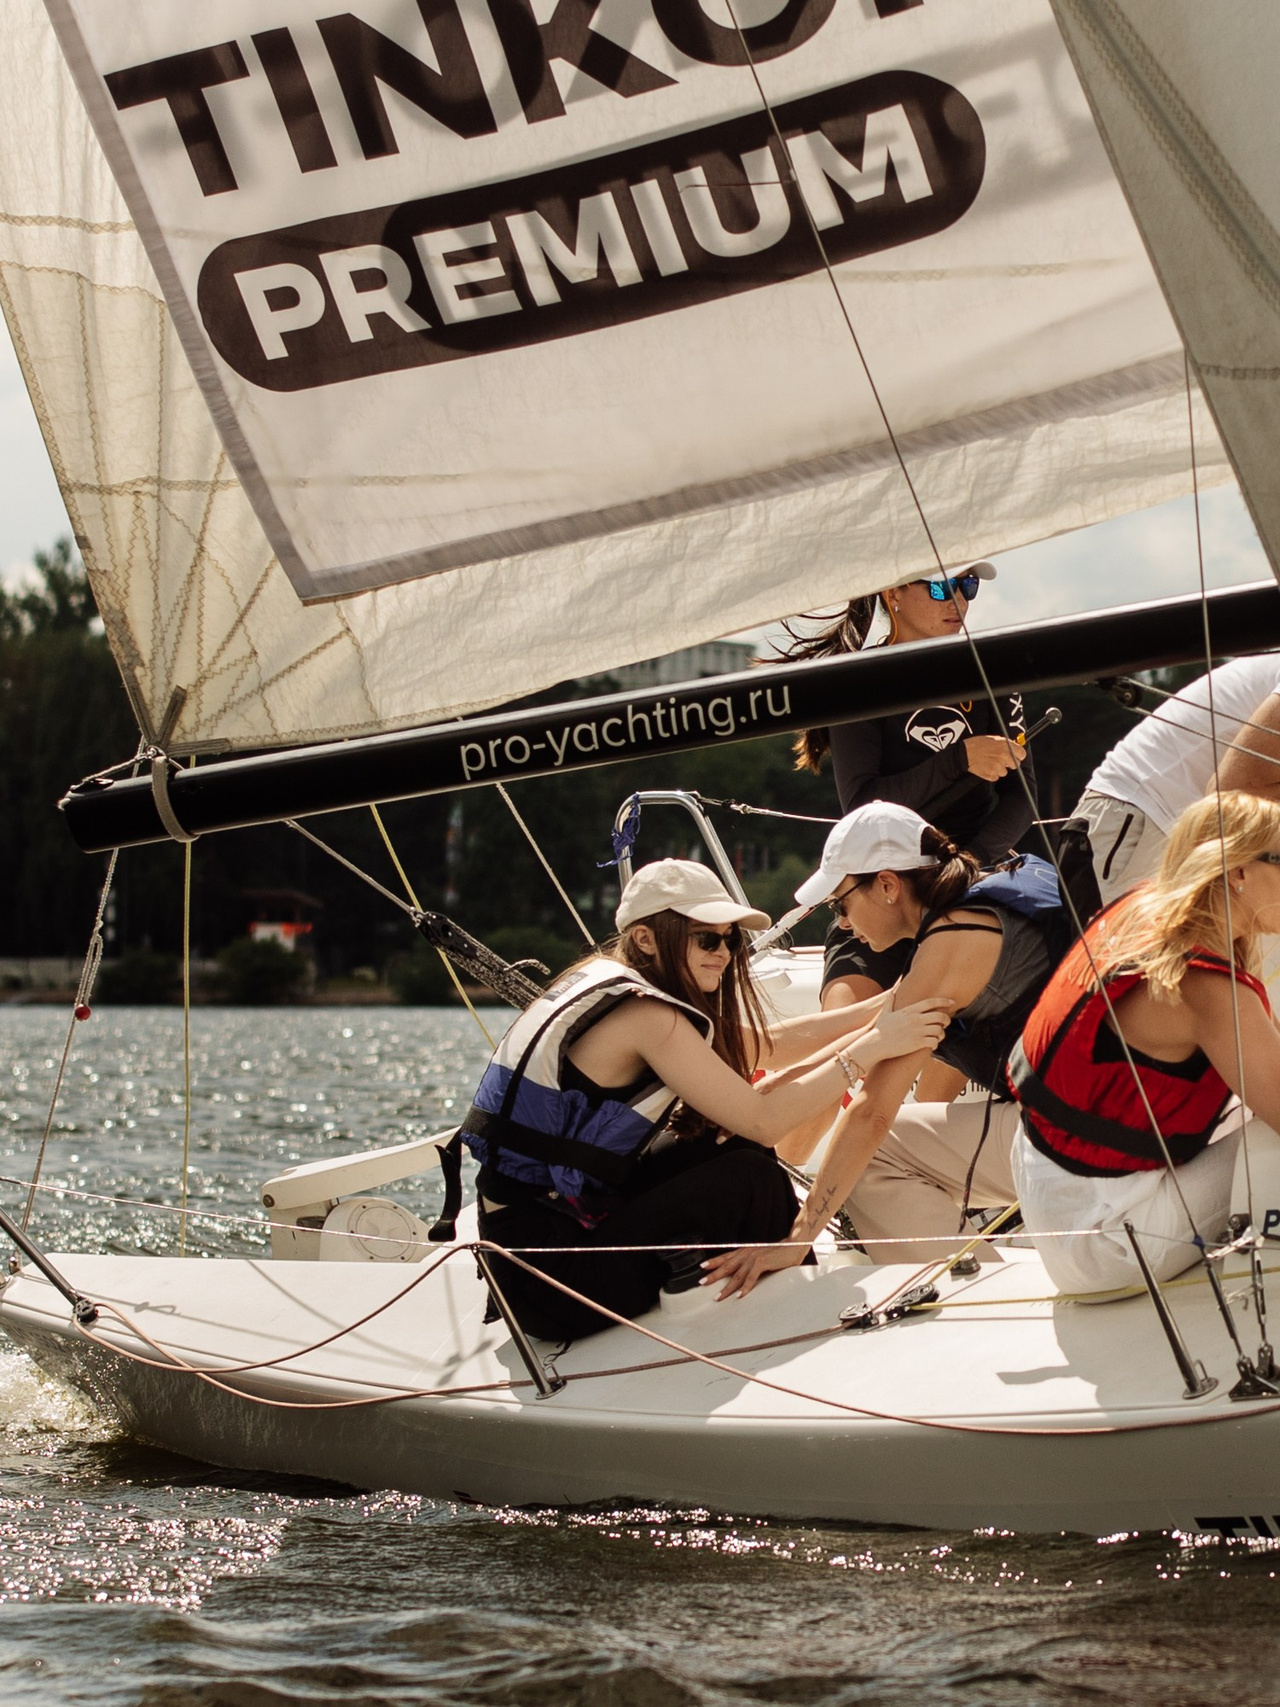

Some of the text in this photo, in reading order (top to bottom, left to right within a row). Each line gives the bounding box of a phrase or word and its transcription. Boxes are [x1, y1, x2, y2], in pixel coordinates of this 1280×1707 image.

[103, 0, 924, 196] TINK
[233, 103, 934, 361] PREMIUM
[460, 685, 792, 780] pro-yachting.ru
